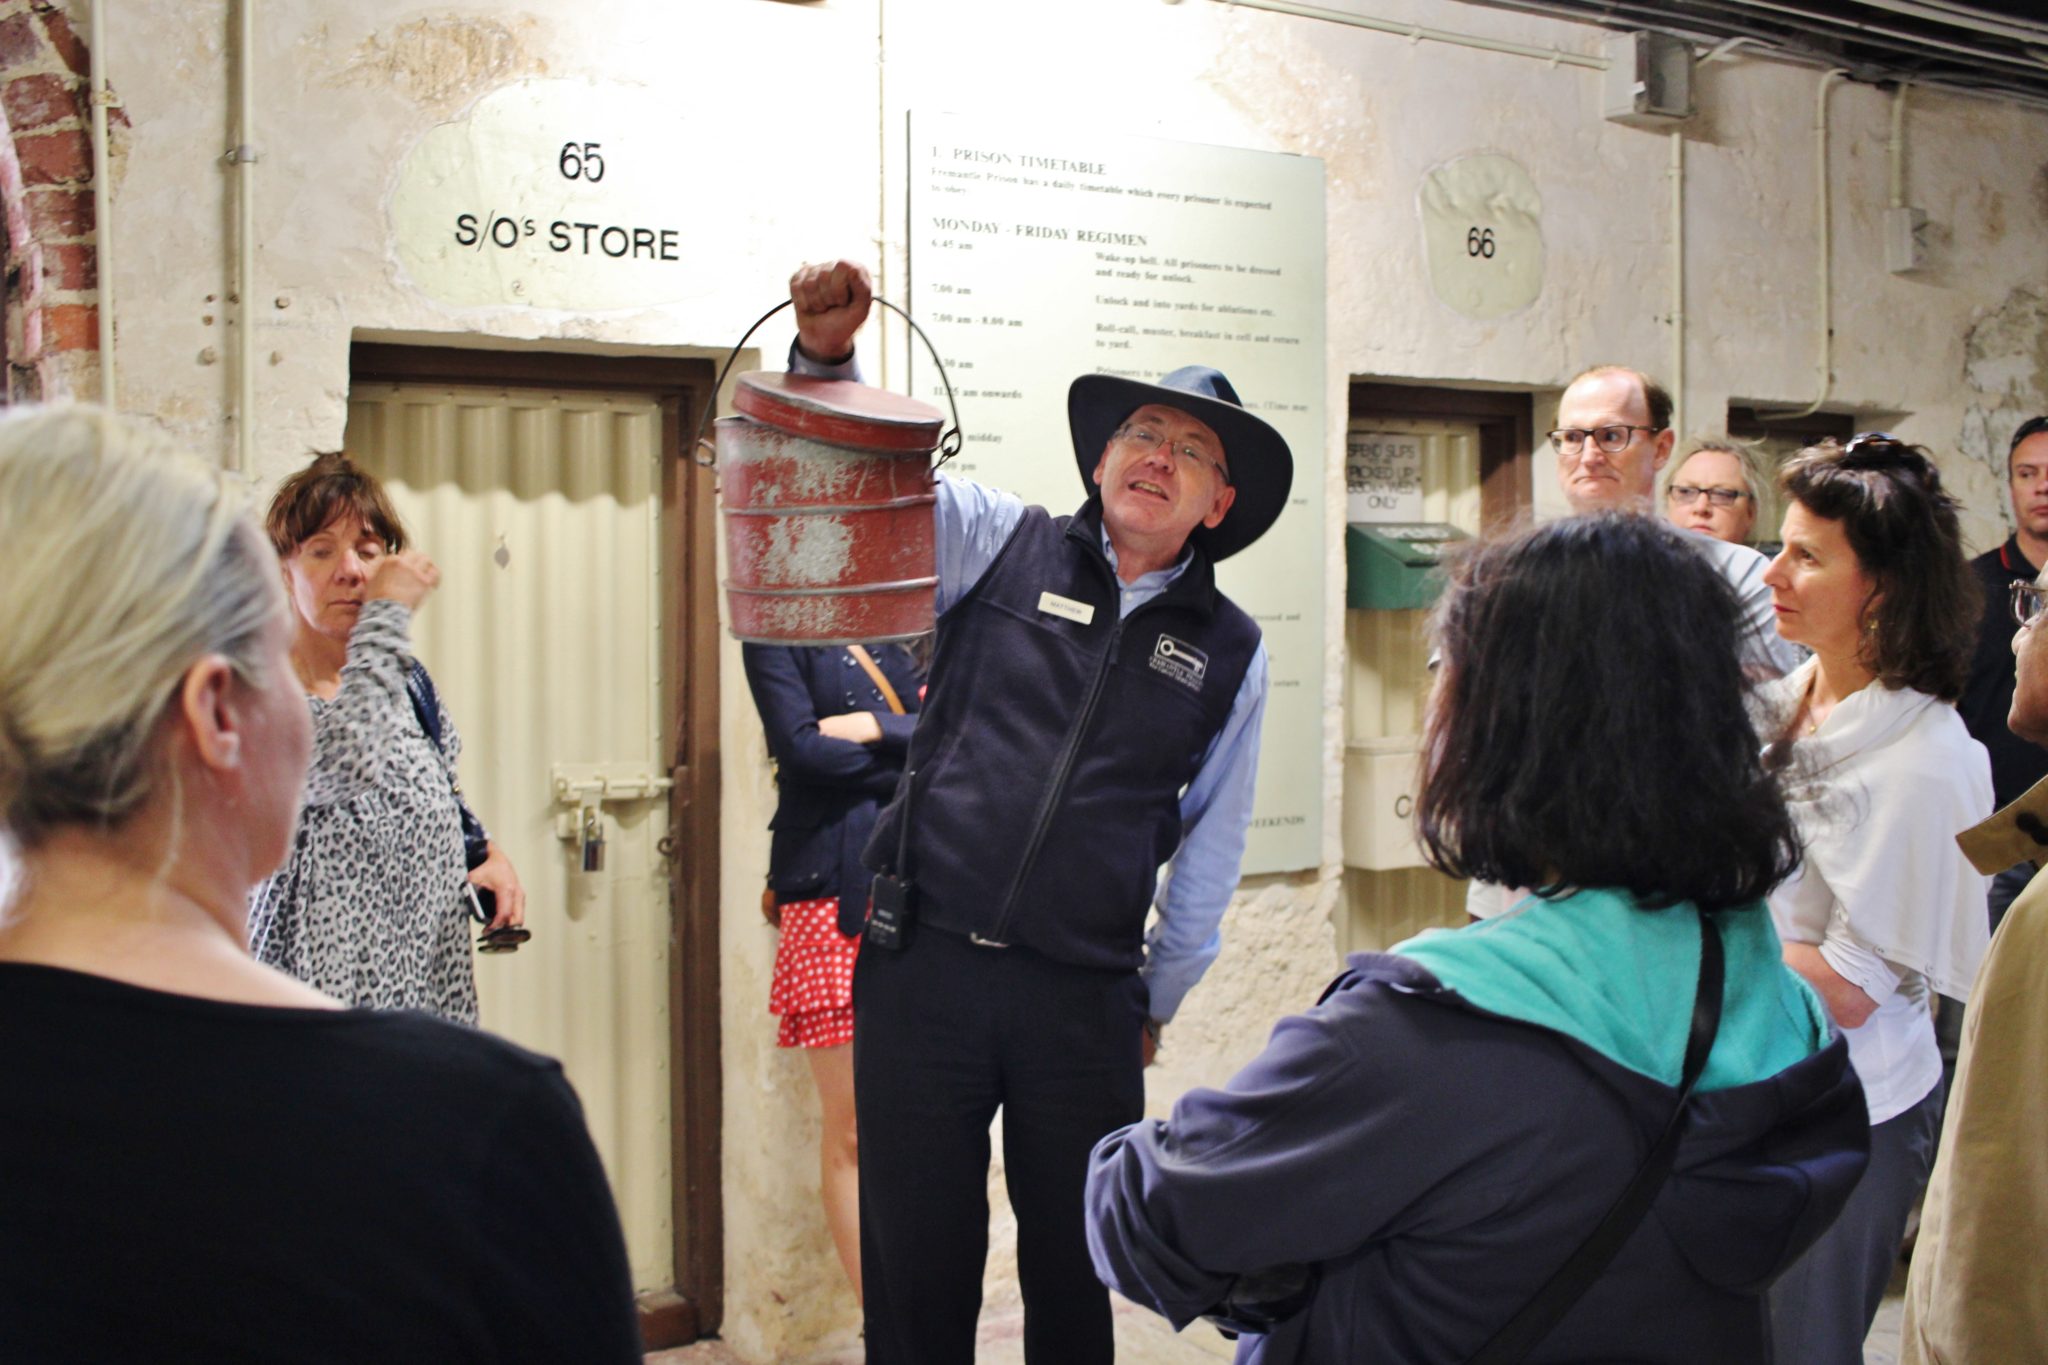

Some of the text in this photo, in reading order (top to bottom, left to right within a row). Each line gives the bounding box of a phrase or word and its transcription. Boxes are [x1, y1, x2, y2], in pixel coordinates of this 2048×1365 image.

[560, 141, 605, 183] 65
[953, 148, 1012, 164] PRISON
[1018, 155, 1107, 175] TIMETABLE
[986, 172, 1018, 184] Prison
[1023, 176, 1039, 186] has
[1052, 180, 1075, 191] daily
[1079, 183, 1123, 195] timetable
[1127, 187, 1153, 198] which
[1157, 191, 1180, 202] every
[1184, 193, 1220, 205] prisoner
[1234, 200, 1272, 210] expected
[549, 221, 680, 261] STORE
[932, 217, 1000, 234] MONDAY
[1016, 224, 1070, 240] FRIDAY
[1076, 229, 1148, 247] REGIMEN
[1468, 227, 1495, 259] 66
[931, 239, 954, 249] 6.45
[1095, 252, 1281, 276] Wake-up bell. All prisoners to be dressed
[1095, 268, 1197, 284] and ready for unlock.
[932, 283, 952, 293] 7.00
[1095, 295, 1128, 306] Unlock
[1133, 298, 1149, 308] and
[1153, 299, 1171, 309] into
[1174, 300, 1198, 312] yards
[1201, 302, 1214, 312] for
[1260, 307, 1276, 317] etc.
[932, 312, 952, 323] 7.00
[957, 316, 972, 324] am
[982, 316, 1004, 326] 8.00
[1008, 320, 1023, 328] am
[1095, 323, 1139, 335] Roll-call,
[1179, 328, 1221, 340] breakfast
[1224, 331, 1232, 341] in
[1236, 332, 1251, 342] cell
[1254, 333, 1270, 343] and
[1273, 335, 1300, 345] return
[1095, 339, 1133, 349] to yard.
[958, 361, 974, 369] am
[963, 389, 979, 397] am
[981, 389, 1023, 399] onwards
[967, 432, 1002, 444] midday
